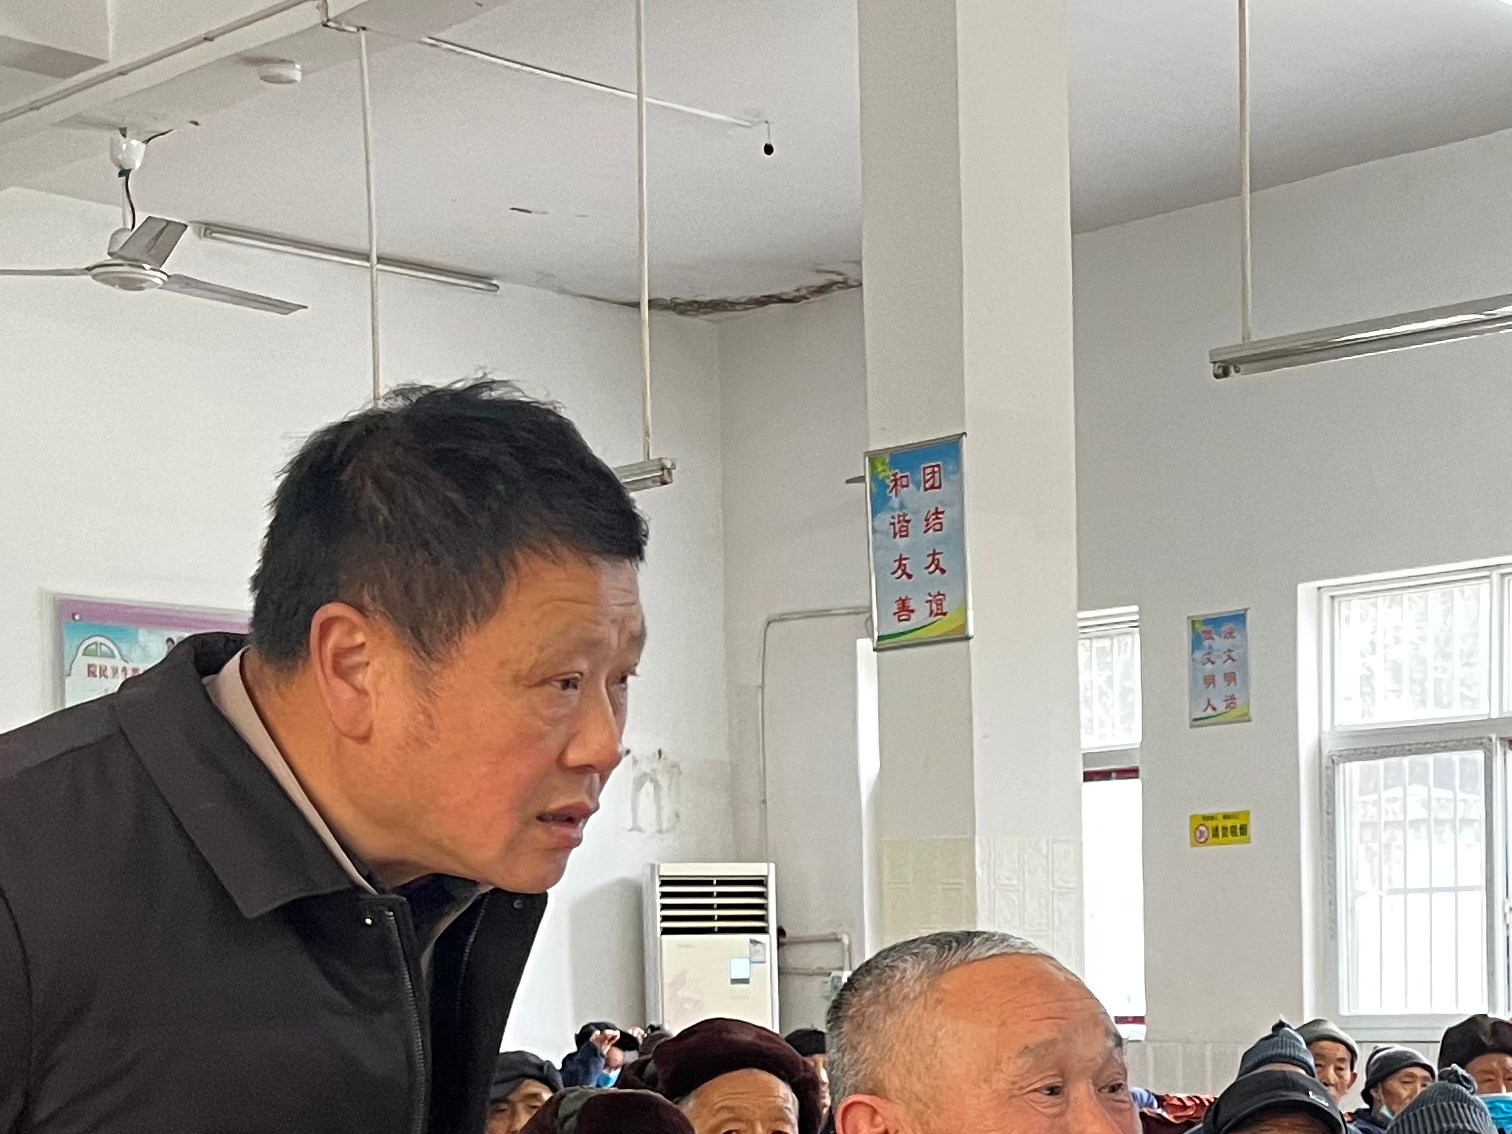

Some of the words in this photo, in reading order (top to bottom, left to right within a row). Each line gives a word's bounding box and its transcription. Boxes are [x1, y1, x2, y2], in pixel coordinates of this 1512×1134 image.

[888, 471, 915, 623] 和谐友善
[922, 463, 949, 618] 团结友谊
